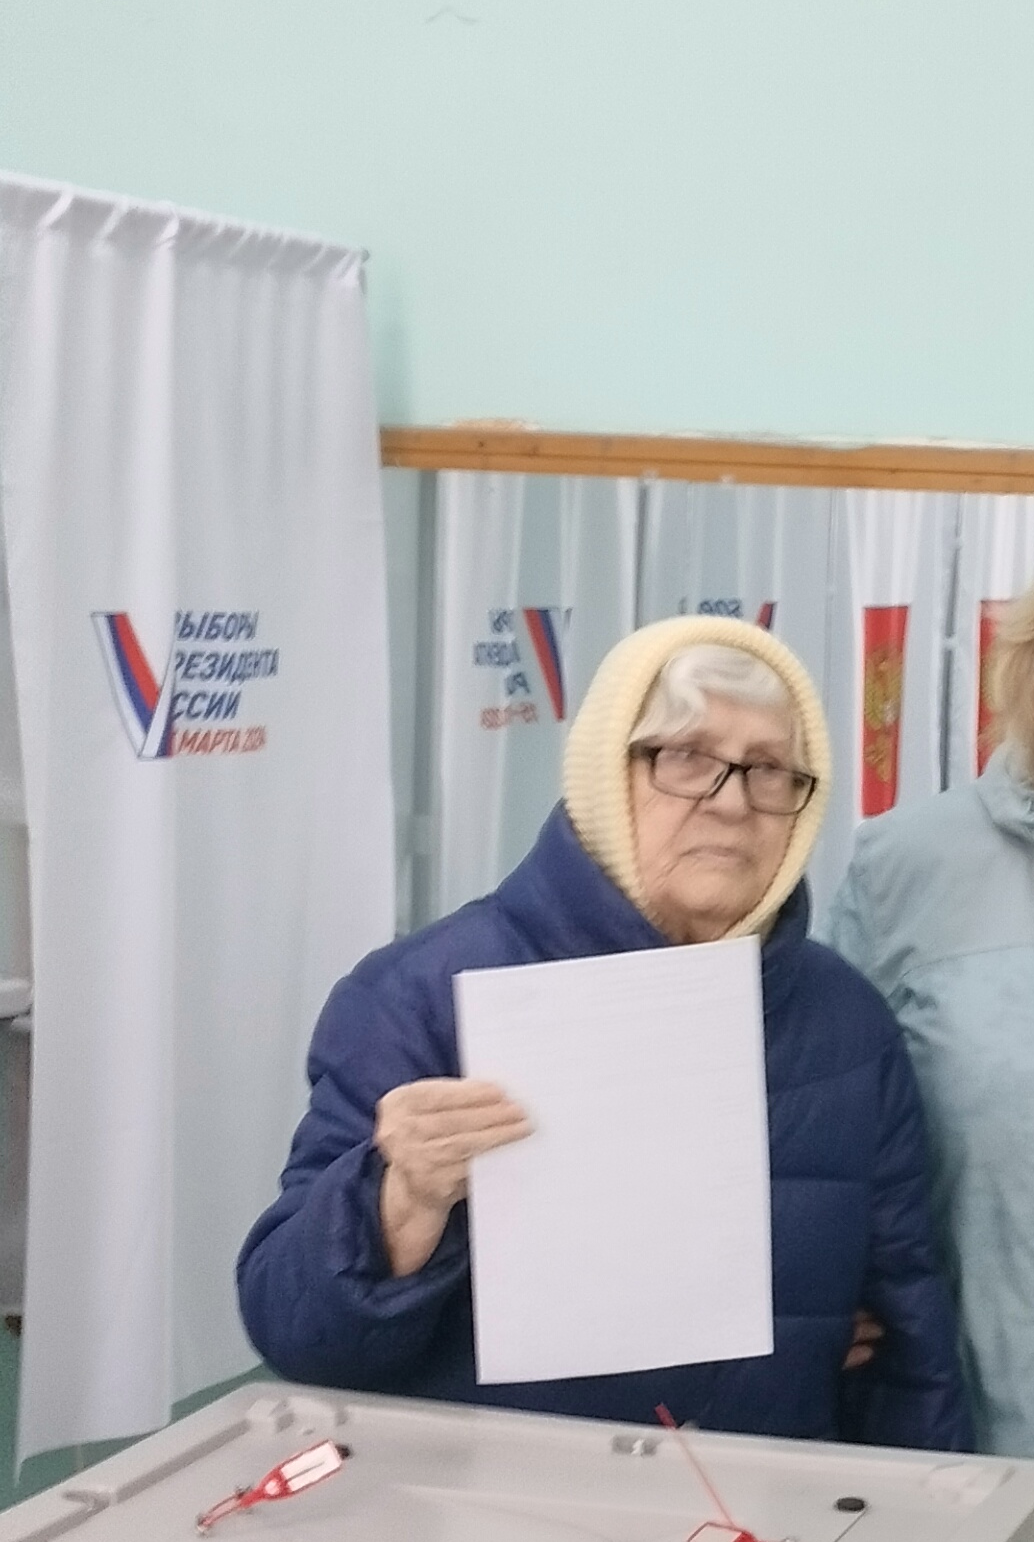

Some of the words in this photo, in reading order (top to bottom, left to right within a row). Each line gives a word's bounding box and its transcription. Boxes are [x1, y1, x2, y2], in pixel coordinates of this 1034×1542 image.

[175, 610, 259, 641] ЫБОРЫ
[175, 648, 279, 685] РЕЗИДЕНТА
[171, 690, 242, 721] ССИИ
